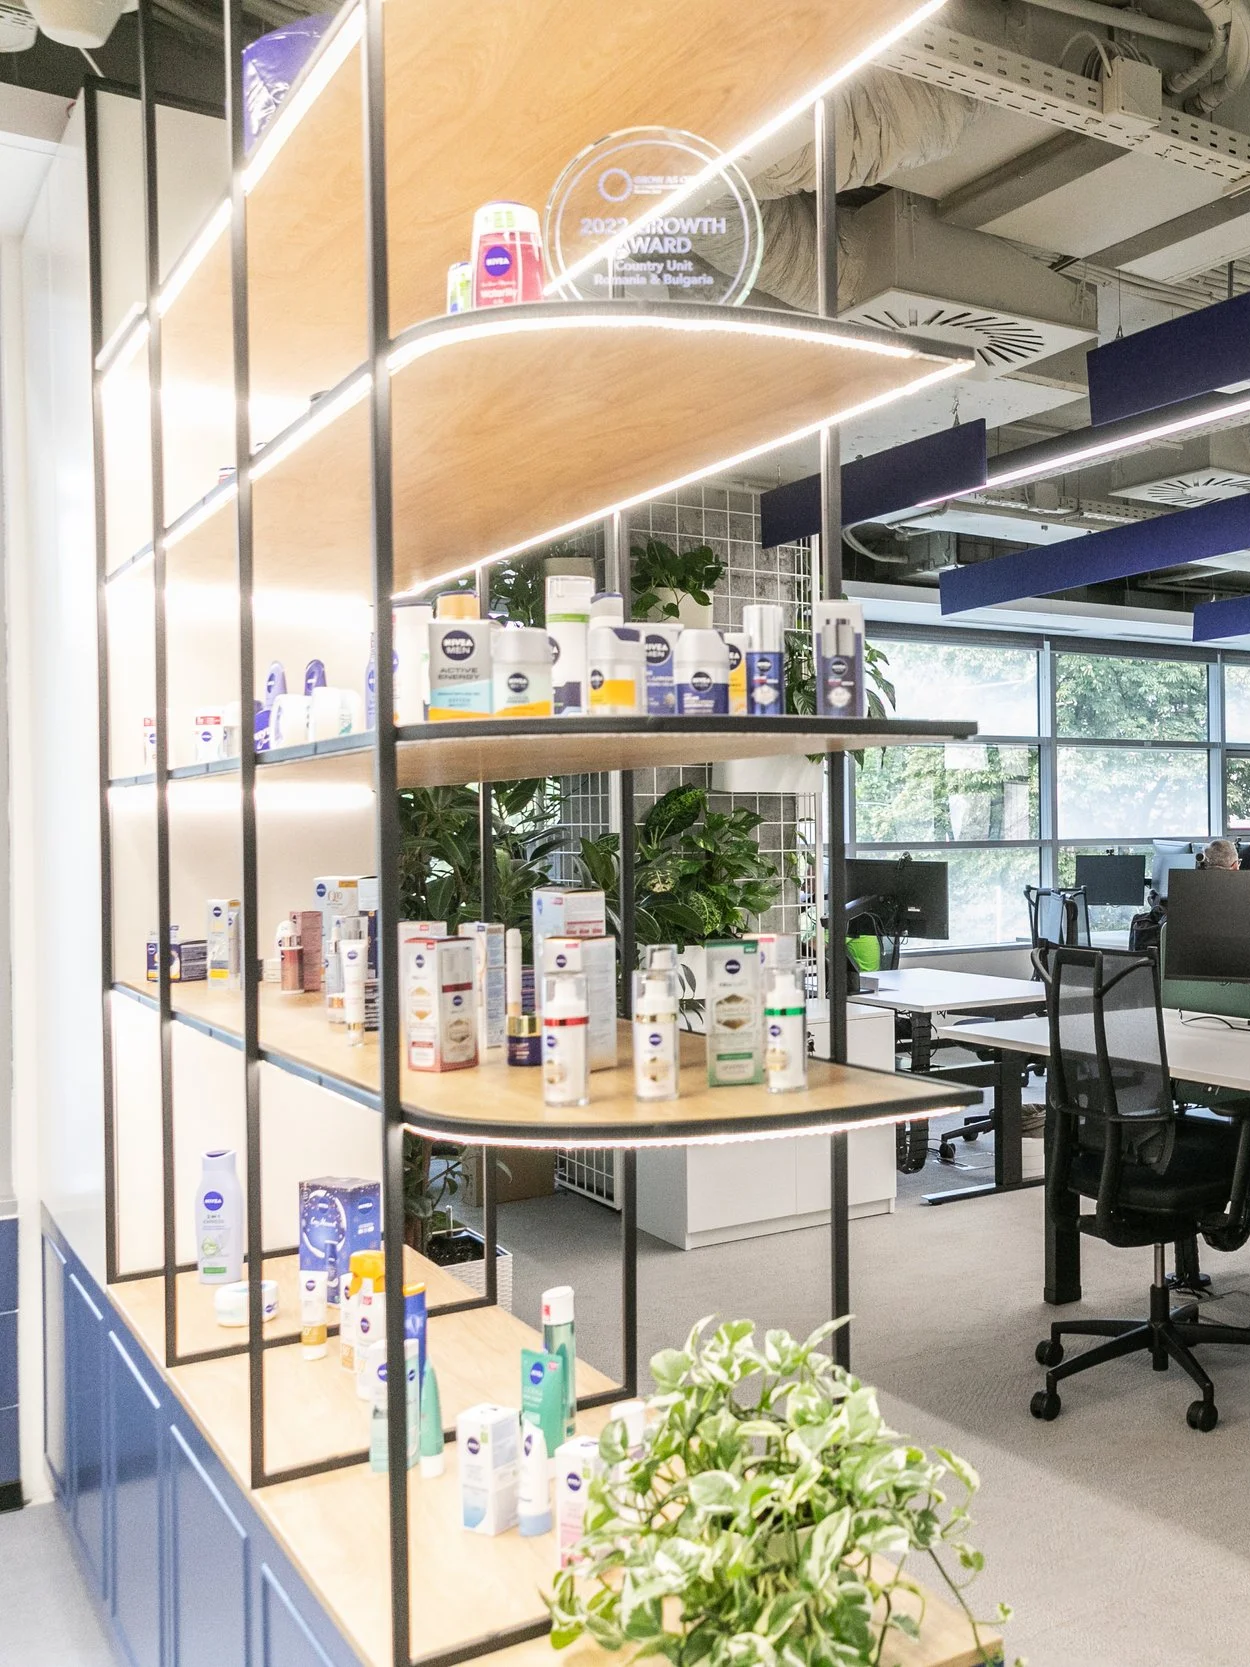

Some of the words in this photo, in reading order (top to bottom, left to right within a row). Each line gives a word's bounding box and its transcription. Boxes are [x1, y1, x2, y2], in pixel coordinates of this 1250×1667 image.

[615, 260, 664, 273] Country
[666, 260, 694, 271] Unit
[594, 274, 647, 285] Romania
[663, 273, 714, 288] Bulgaria
[443, 638, 474, 647] NIVEA
